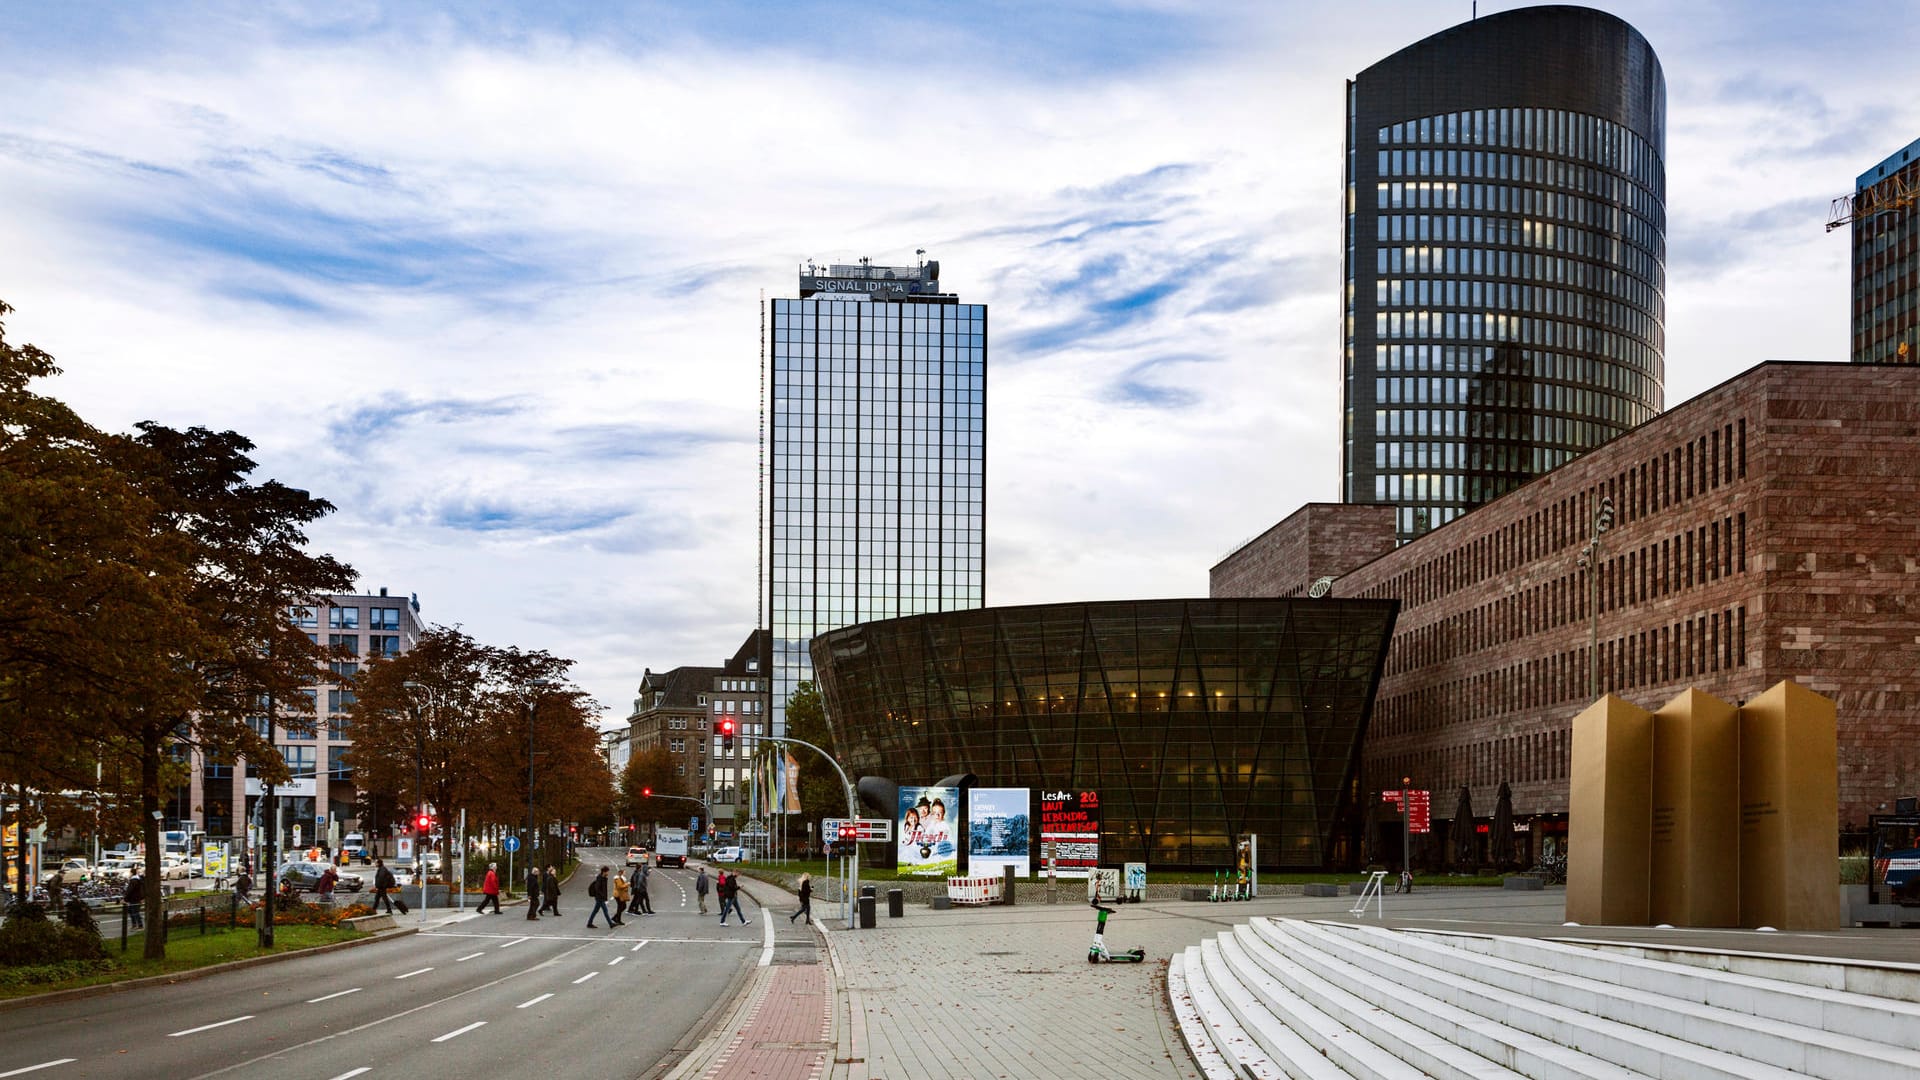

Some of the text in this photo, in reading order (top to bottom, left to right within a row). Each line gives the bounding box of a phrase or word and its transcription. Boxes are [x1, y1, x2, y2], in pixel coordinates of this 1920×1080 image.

[816, 280, 861, 290] SIGNAL
[1079, 791, 1099, 803] 20.
[1041, 801, 1063, 811] LAUT
[1042, 812, 1088, 822] LEBENDIG
